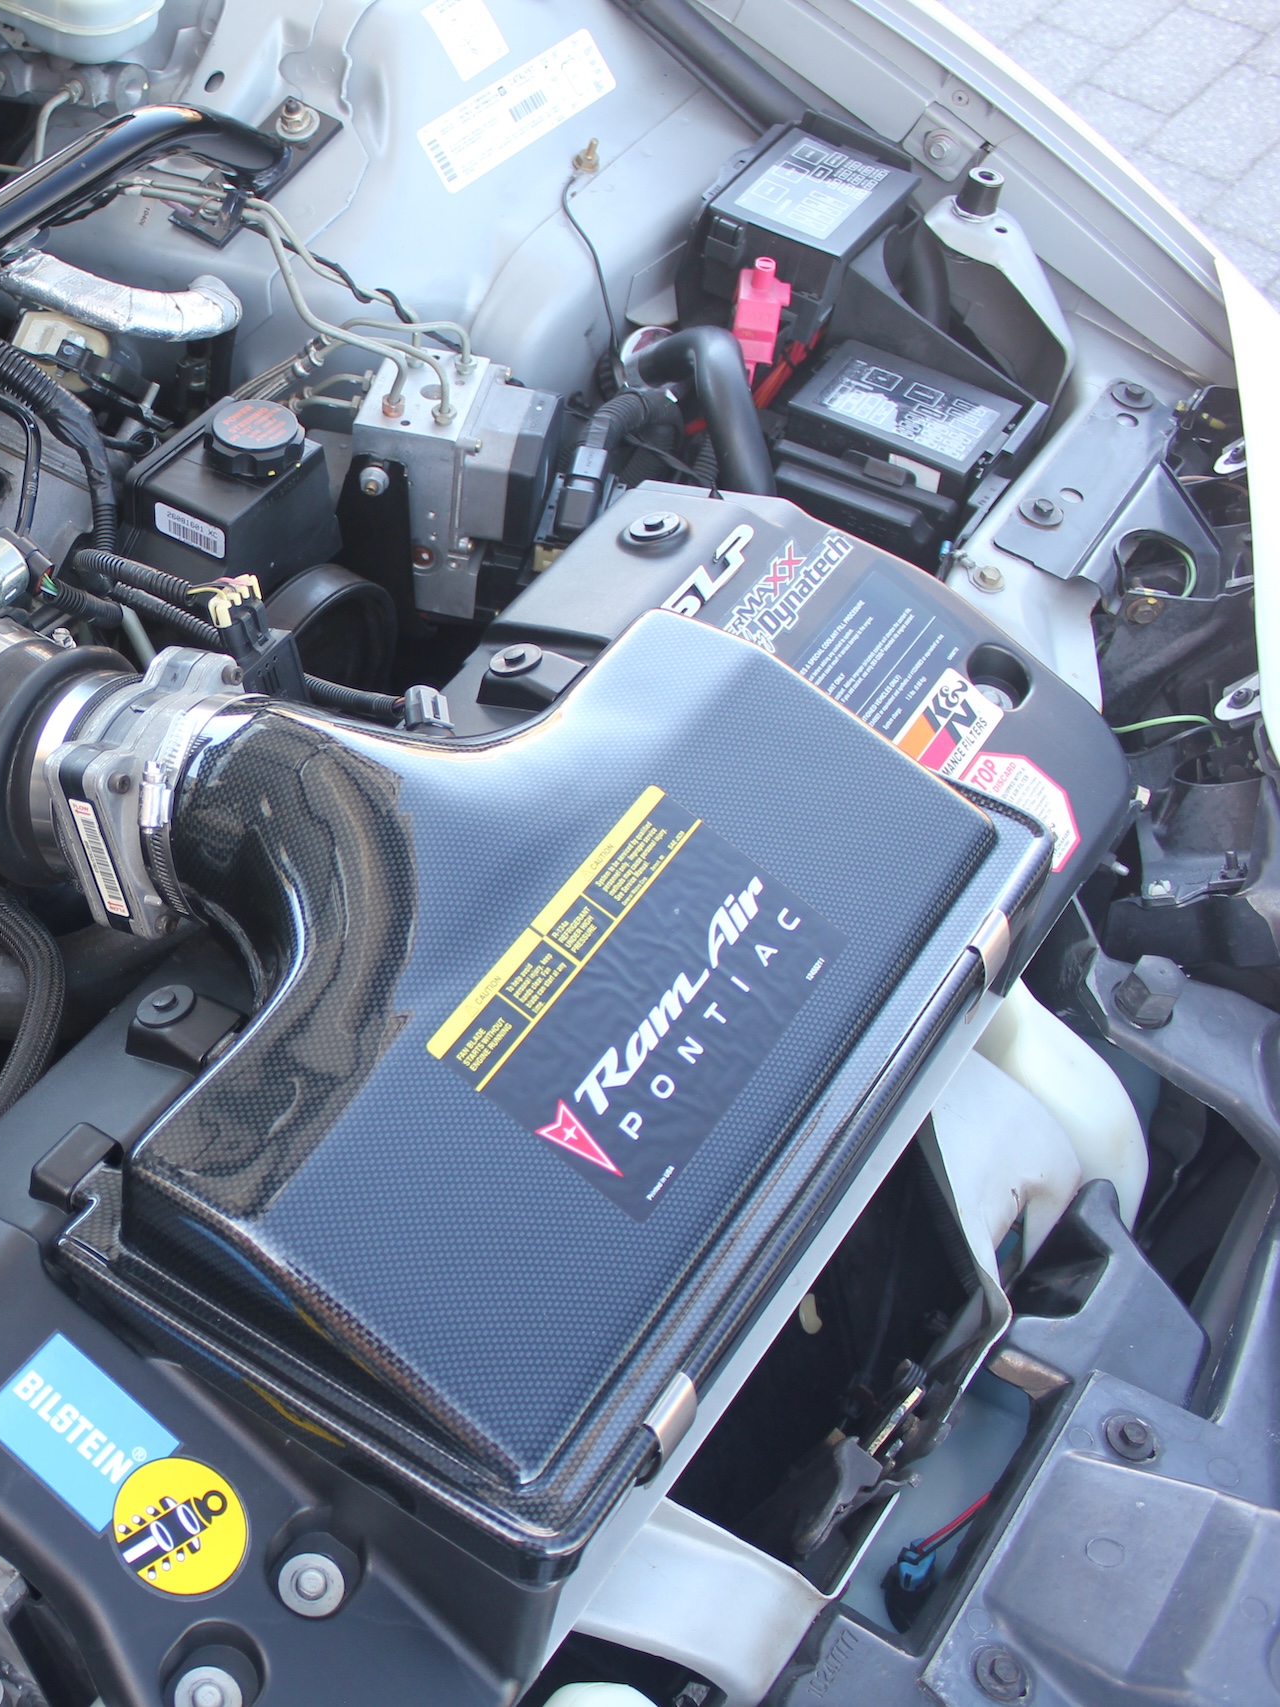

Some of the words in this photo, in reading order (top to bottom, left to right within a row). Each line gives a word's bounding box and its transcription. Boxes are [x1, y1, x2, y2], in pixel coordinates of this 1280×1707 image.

[208, 529, 218, 539] XC
[757, 533, 854, 636] Dynatech
[807, 646, 825, 666] SPECIAL
[820, 628, 839, 650] COOLANT
[960, 716, 989, 751] FILTERS
[989, 760, 1019, 793] DISCARD
[1015, 773, 1030, 790] FILTER
[73, 803, 89, 812] FLOW
[589, 842, 614, 871] CAUTION
[557, 905, 591, 944] REFRIGERANT
[563, 927, 583, 949] UNDER
[579, 914, 594, 930] HIGH
[570, 922, 598, 953] PRESSURE
[473, 974, 502, 1006] CAUTION
[574, 965, 709, 1116] Ram
[708, 876, 764, 968] Air
[462, 1041, 485, 1067] STARTS
[480, 1016, 506, 1045] WITHOUT
[618, 908, 801, 1141] PONTIAC
[455, 1046, 470, 1061] FAN
[465, 1026, 486, 1050] BLADE
[469, 1047, 491, 1072] ENGINE
[487, 1021, 513, 1050] RUNNING
[645, 1182, 663, 1201] Printed
[661, 1163, 677, 1179] USA
